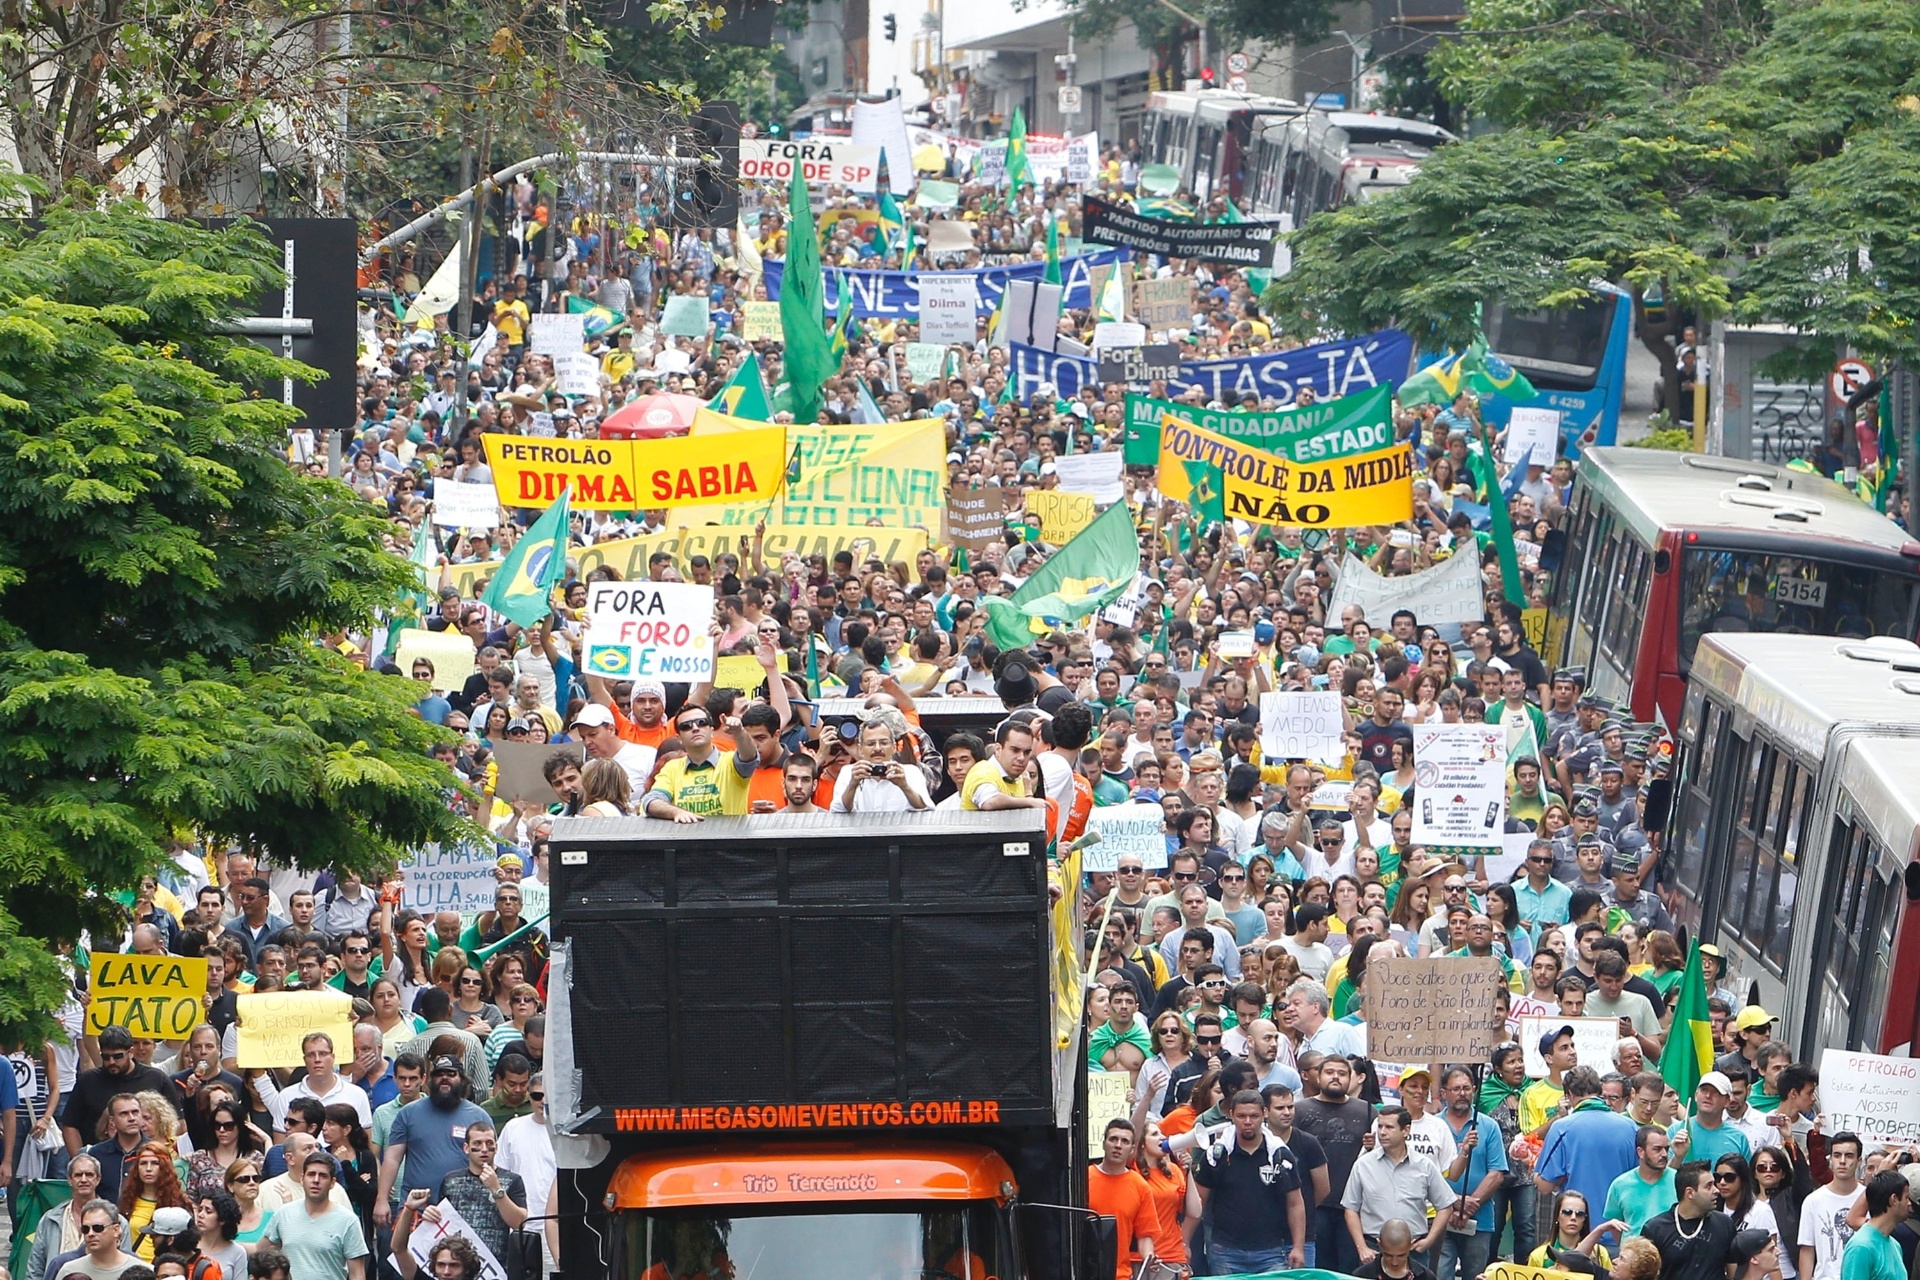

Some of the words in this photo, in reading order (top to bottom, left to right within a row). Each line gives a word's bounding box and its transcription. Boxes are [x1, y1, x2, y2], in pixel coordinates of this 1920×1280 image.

[768, 143, 833, 162] FORA
[738, 159, 791, 177] ORO
[803, 162, 831, 181] DE
[842, 165, 871, 183] SP
[1108, 212, 1159, 236] PARTIDO
[1162, 227, 1241, 240] AUTORITÁRIO
[1245, 226, 1272, 241] COM
[1092, 225, 1170, 253] PRETENSÕES
[1177, 243, 1261, 262] TOTALITÁRIAS
[929, 298, 966, 309] Dilma
[1100, 346, 1145, 364] Fora
[1124, 362, 1179, 381] Dilma
[1132, 400, 1194, 424] MAIS
[1202, 407, 1335, 437] CIDADANIA
[1294, 421, 1387, 462] ESTADO
[501, 442, 613, 466] PETROLÃO
[1163, 423, 1290, 492] CONTROLE
[1297, 468, 1336, 493] DA
[1343, 450, 1413, 491] MIDIA
[517, 469, 635, 503] DILMA
[651, 460, 758, 502] SABIA
[949, 510, 963, 521] DAS
[951, 498, 985, 512] FRAUDE
[1230, 490, 1331, 525] NÃO
[1777, 578, 1822, 602] 5154
[594, 589, 665, 616] FORA
[619, 621, 690, 648] FORO
[660, 655, 711, 674] NOSSO
[1260, 693, 1290, 714] NÃO
[1297, 694, 1341, 714] TEMOS
[1271, 716, 1326, 735] MEDO
[1275, 735, 1298, 756] DO
[1305, 735, 1336, 759] PT
[402, 840, 472, 869] DILMA
[413, 871, 427, 881] DA
[402, 881, 462, 909] LULA
[96, 960, 190, 989] LAVA
[1377, 962, 1411, 986] Você
[1415, 965, 1446, 986] sabe
[1450, 974, 1457, 986] o
[1460, 974, 1488, 995] que
[1379, 992, 1411, 1010] Foro
[1413, 991, 1427, 1009] de
[1434, 990, 1457, 1009] São
[90, 996, 198, 1035] JATO
[262, 1014, 326, 1030] BRASIL
[1438, 1021, 1447, 1031] a
[262, 1031, 291, 1048] NÃO
[1383, 1039, 1448, 1058] Comunismo
[1450, 1044, 1466, 1057] no
[1849, 1058, 1917, 1079] PETROLÃO
[614, 1100, 1000, 1132] WWW.MEGASOMEVENTOS.COM.BR
[1855, 1099, 1898, 1114] NOSSA
[743, 1173, 778, 1193] Trio
[787, 1172, 878, 1193] Terremoto
